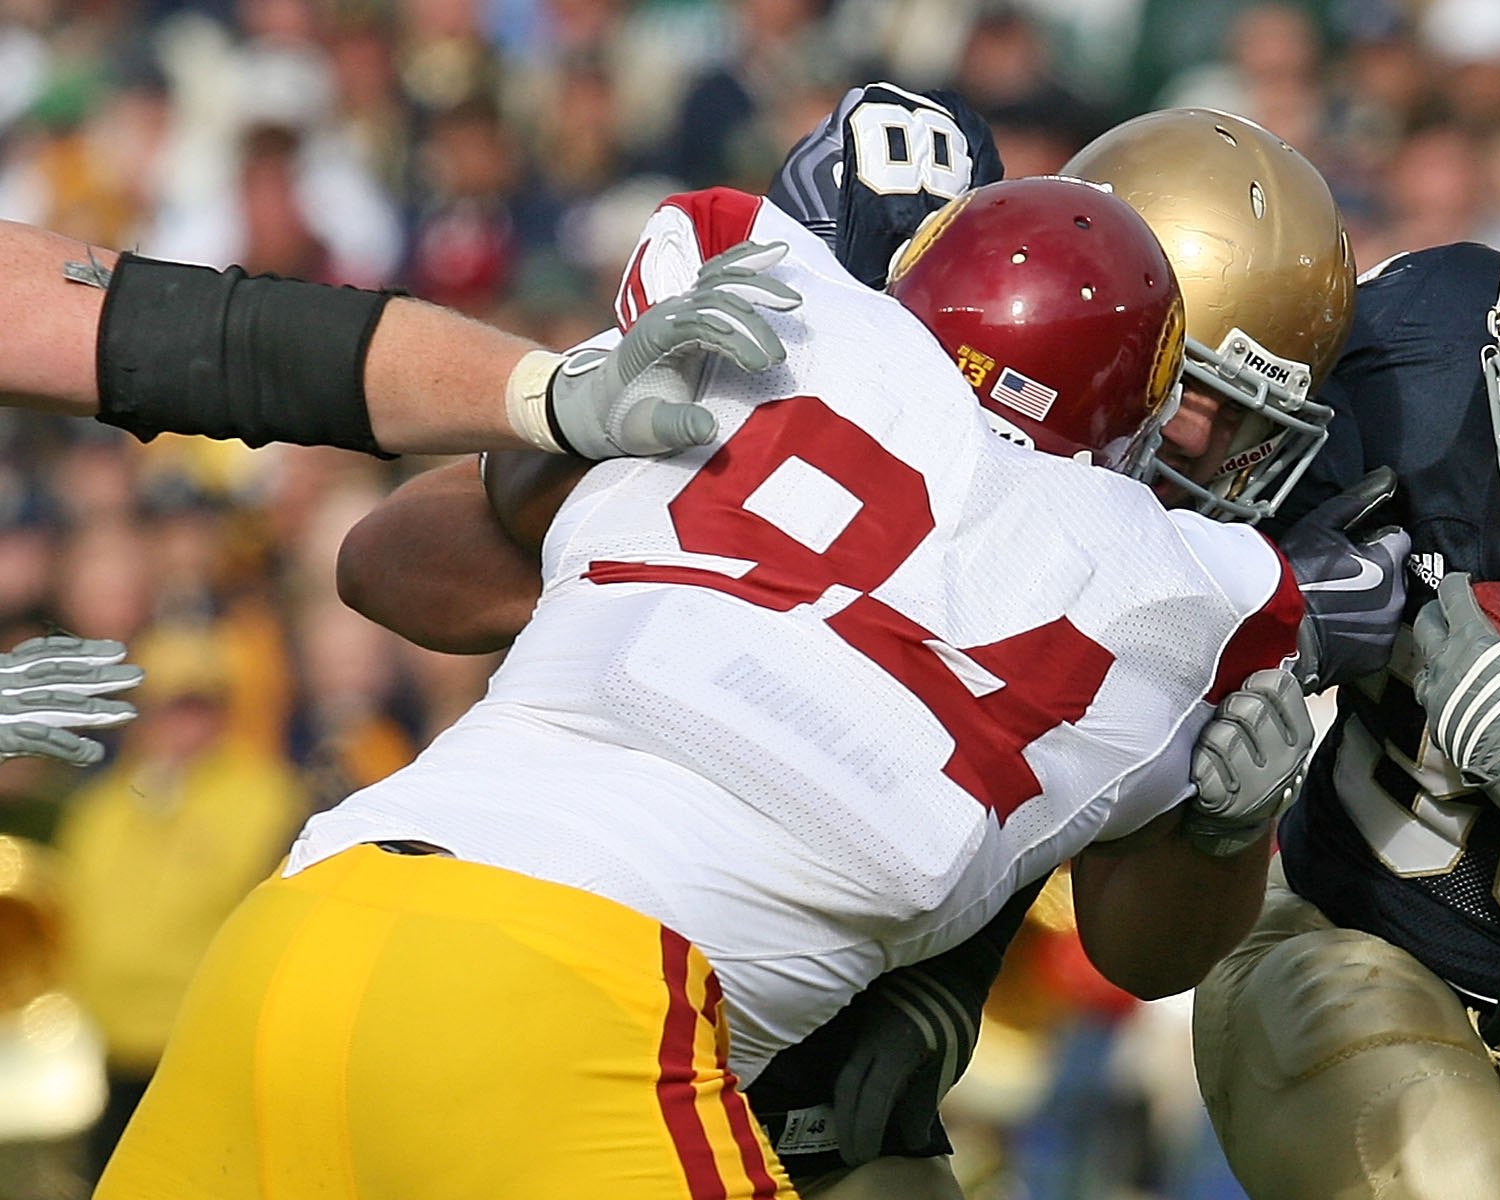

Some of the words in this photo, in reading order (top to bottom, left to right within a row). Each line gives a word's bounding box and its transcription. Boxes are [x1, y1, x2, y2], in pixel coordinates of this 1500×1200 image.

[849, 102, 973, 200] 8
[1244, 350, 1291, 385] IRISH
[1214, 441, 1275, 478] iddell
[580, 395, 1117, 831] 94
